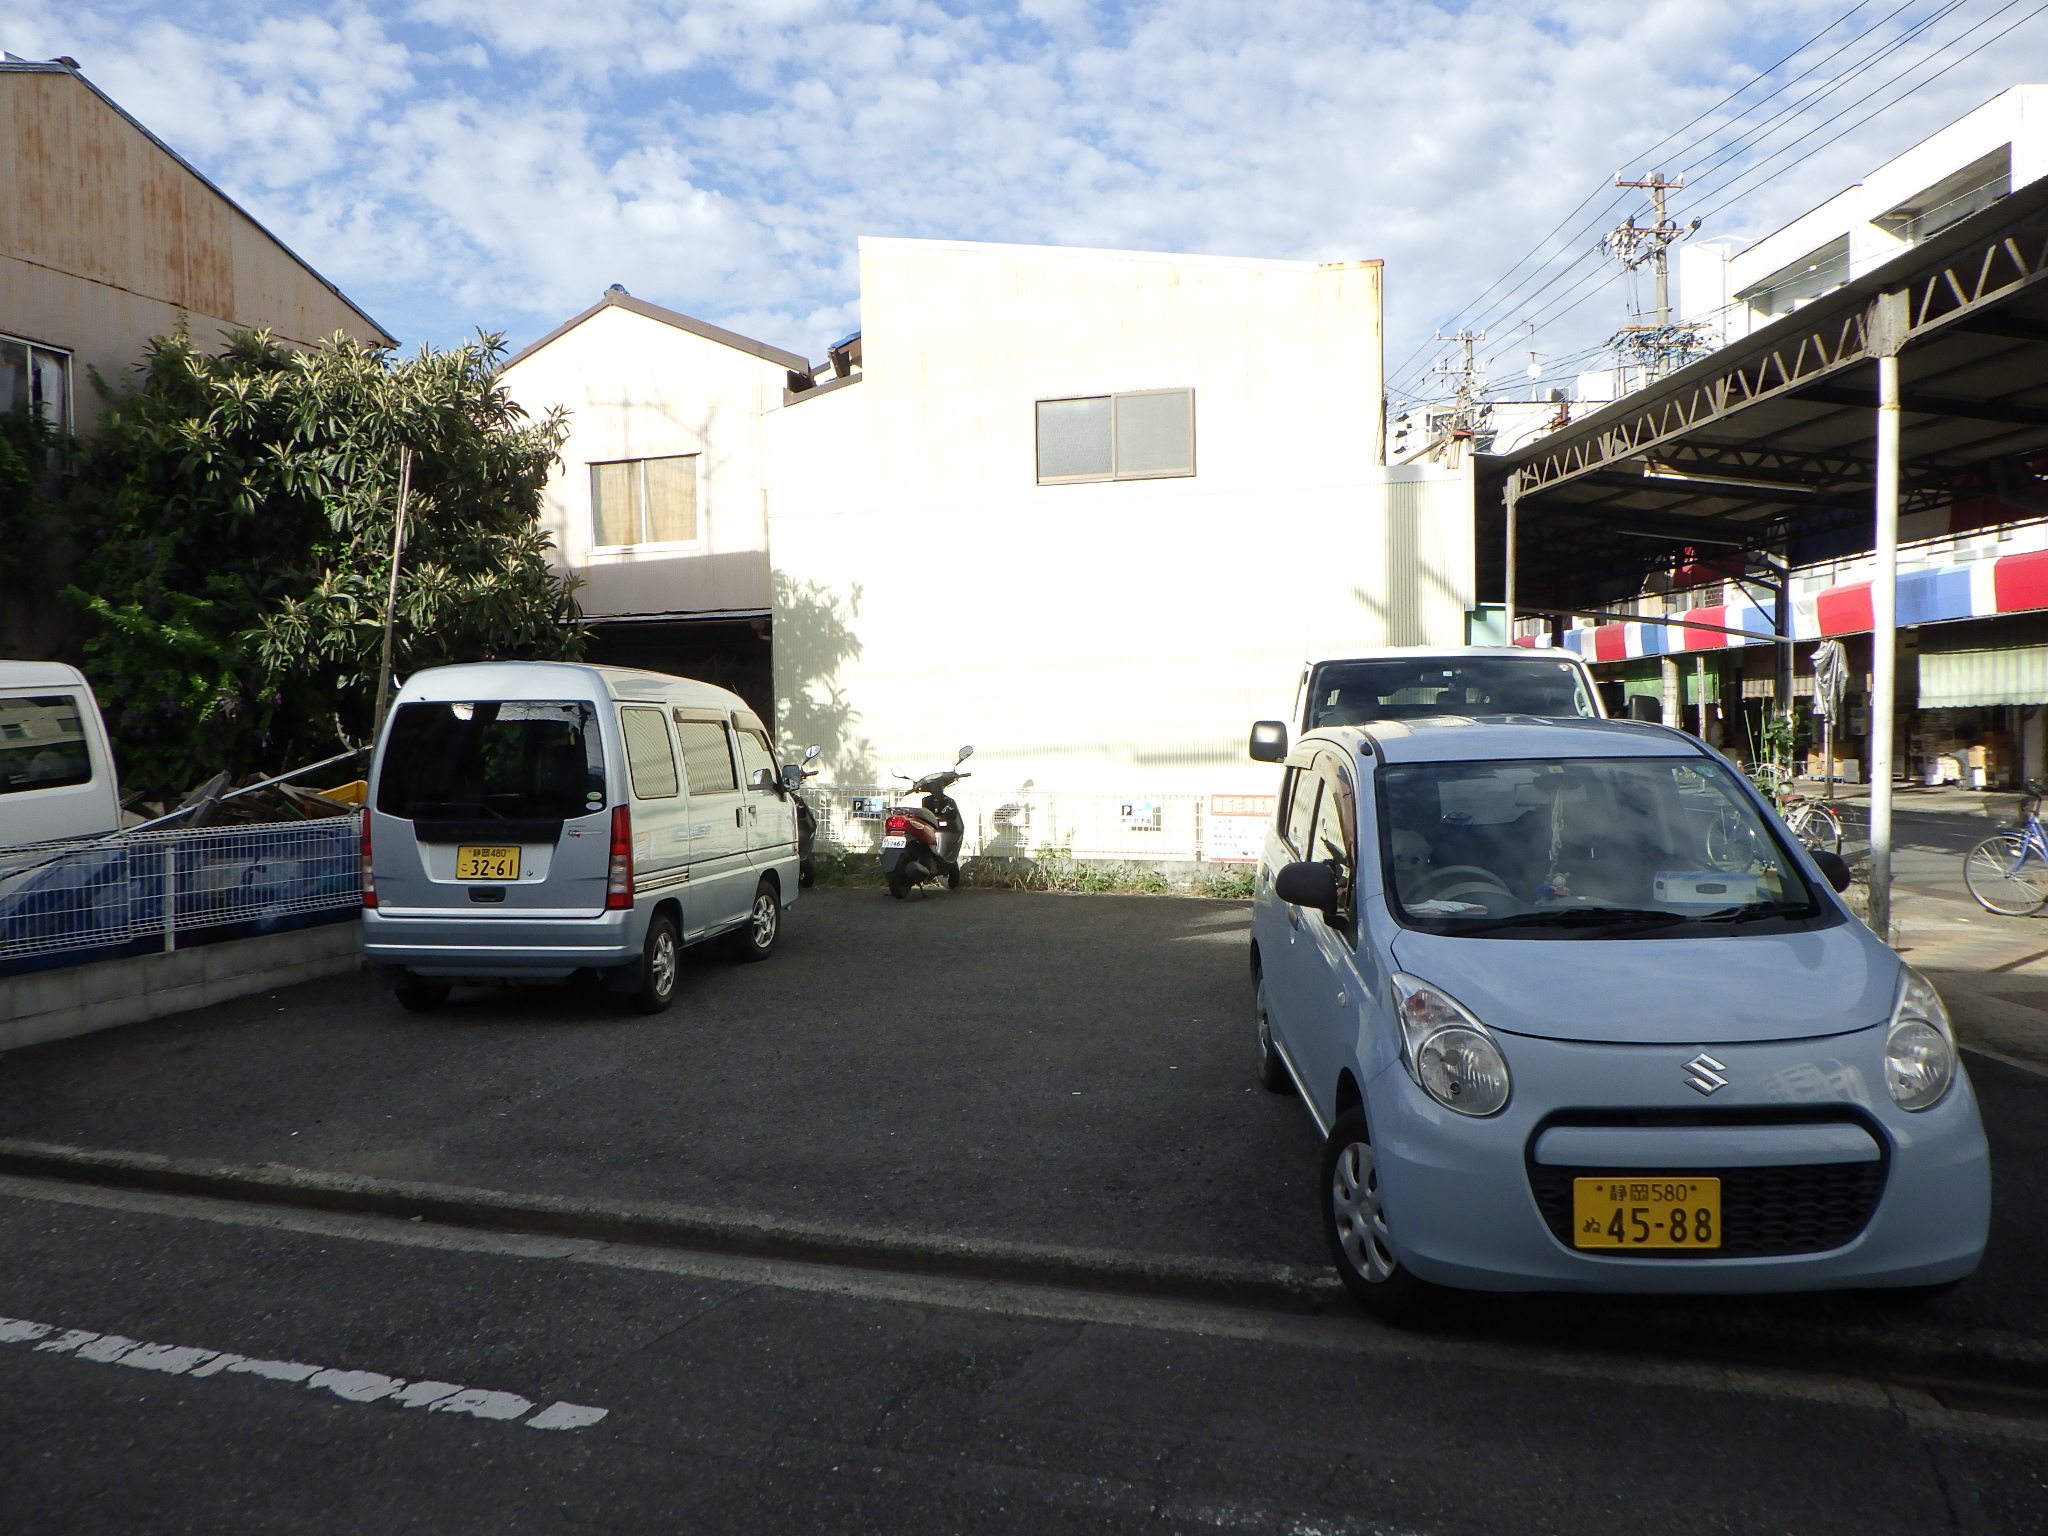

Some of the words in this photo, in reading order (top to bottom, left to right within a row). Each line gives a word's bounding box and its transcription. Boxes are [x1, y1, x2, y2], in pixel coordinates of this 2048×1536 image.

[461, 863, 468, 872] こ
[470, 859, 514, 876] 32-61
[1609, 1183, 1687, 1202] 静岡580
[1582, 1217, 1601, 1234] ぬ
[1607, 1207, 1713, 1244] 45-88
